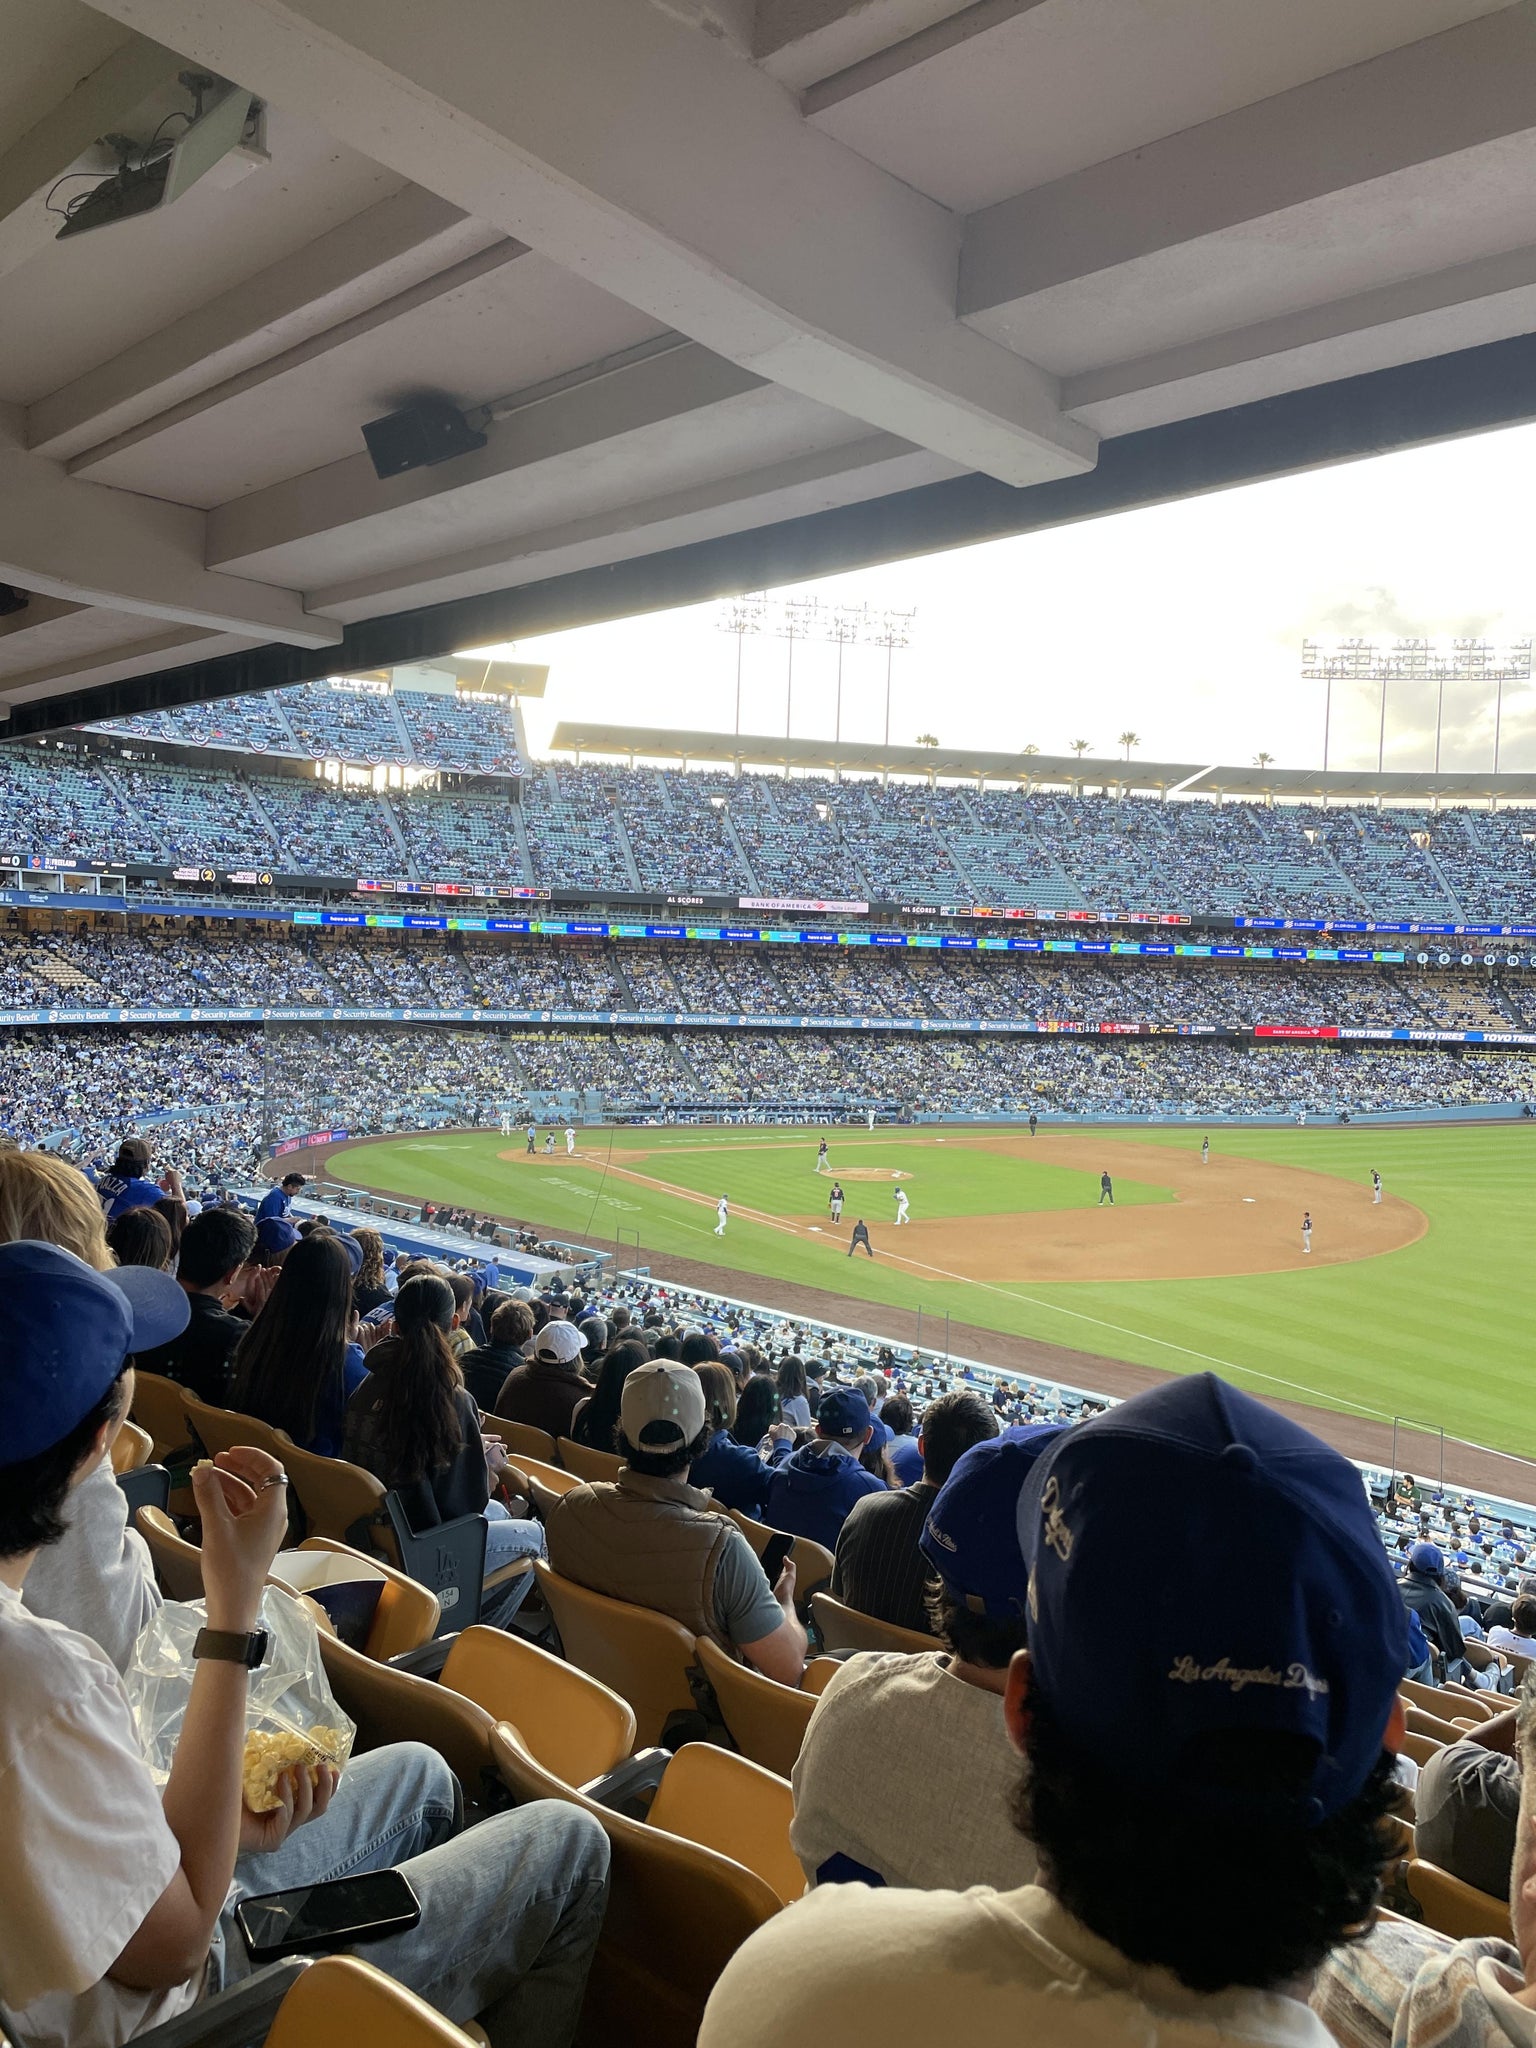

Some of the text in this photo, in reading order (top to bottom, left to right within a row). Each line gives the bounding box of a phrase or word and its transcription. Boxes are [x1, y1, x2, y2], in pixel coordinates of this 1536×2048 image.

[12, 856, 20, 867] 0
[667, 896, 704, 905] AL SCORES
[912, 906, 937, 914] SCORES
[0, 1013, 39, 1024] urity Benefit
[59, 1011, 110, 1021] Security Benefit
[130, 1011, 155, 1020] Security
[201, 1010, 251, 1019] Security Benefit
[272, 1010, 322, 1020] Security Benefit
[342, 1011, 369, 1020] Security
[413, 1011, 463, 1020] Security Benefit
[482, 1011, 531, 1021] Security Benefit
[552, 1012, 600, 1022] Security Benefit
[619, 1014, 643, 1023] Security
[684, 1016, 708, 1024] Security
[747, 1017, 771, 1025] Security
[809, 1018, 833, 1026] Security
[870, 1020, 892, 1029] Security
[929, 1021, 951, 1029] Security
[988, 1022, 1008, 1030] Security
[1366, 1030, 1393, 1038] TIRES
[1409, 1031, 1465, 1040] TOYO TIRES
[1483, 1033, 1536, 1042] TOYO TIRE
[387, 1225, 480, 1251] STADIUM
[441, 1589, 454, 1598] 154
[444, 1599, 450, 1607] N
[1168, 1655, 1200, 1683] Los
[1202, 1657, 1282, 1692] Angeles
